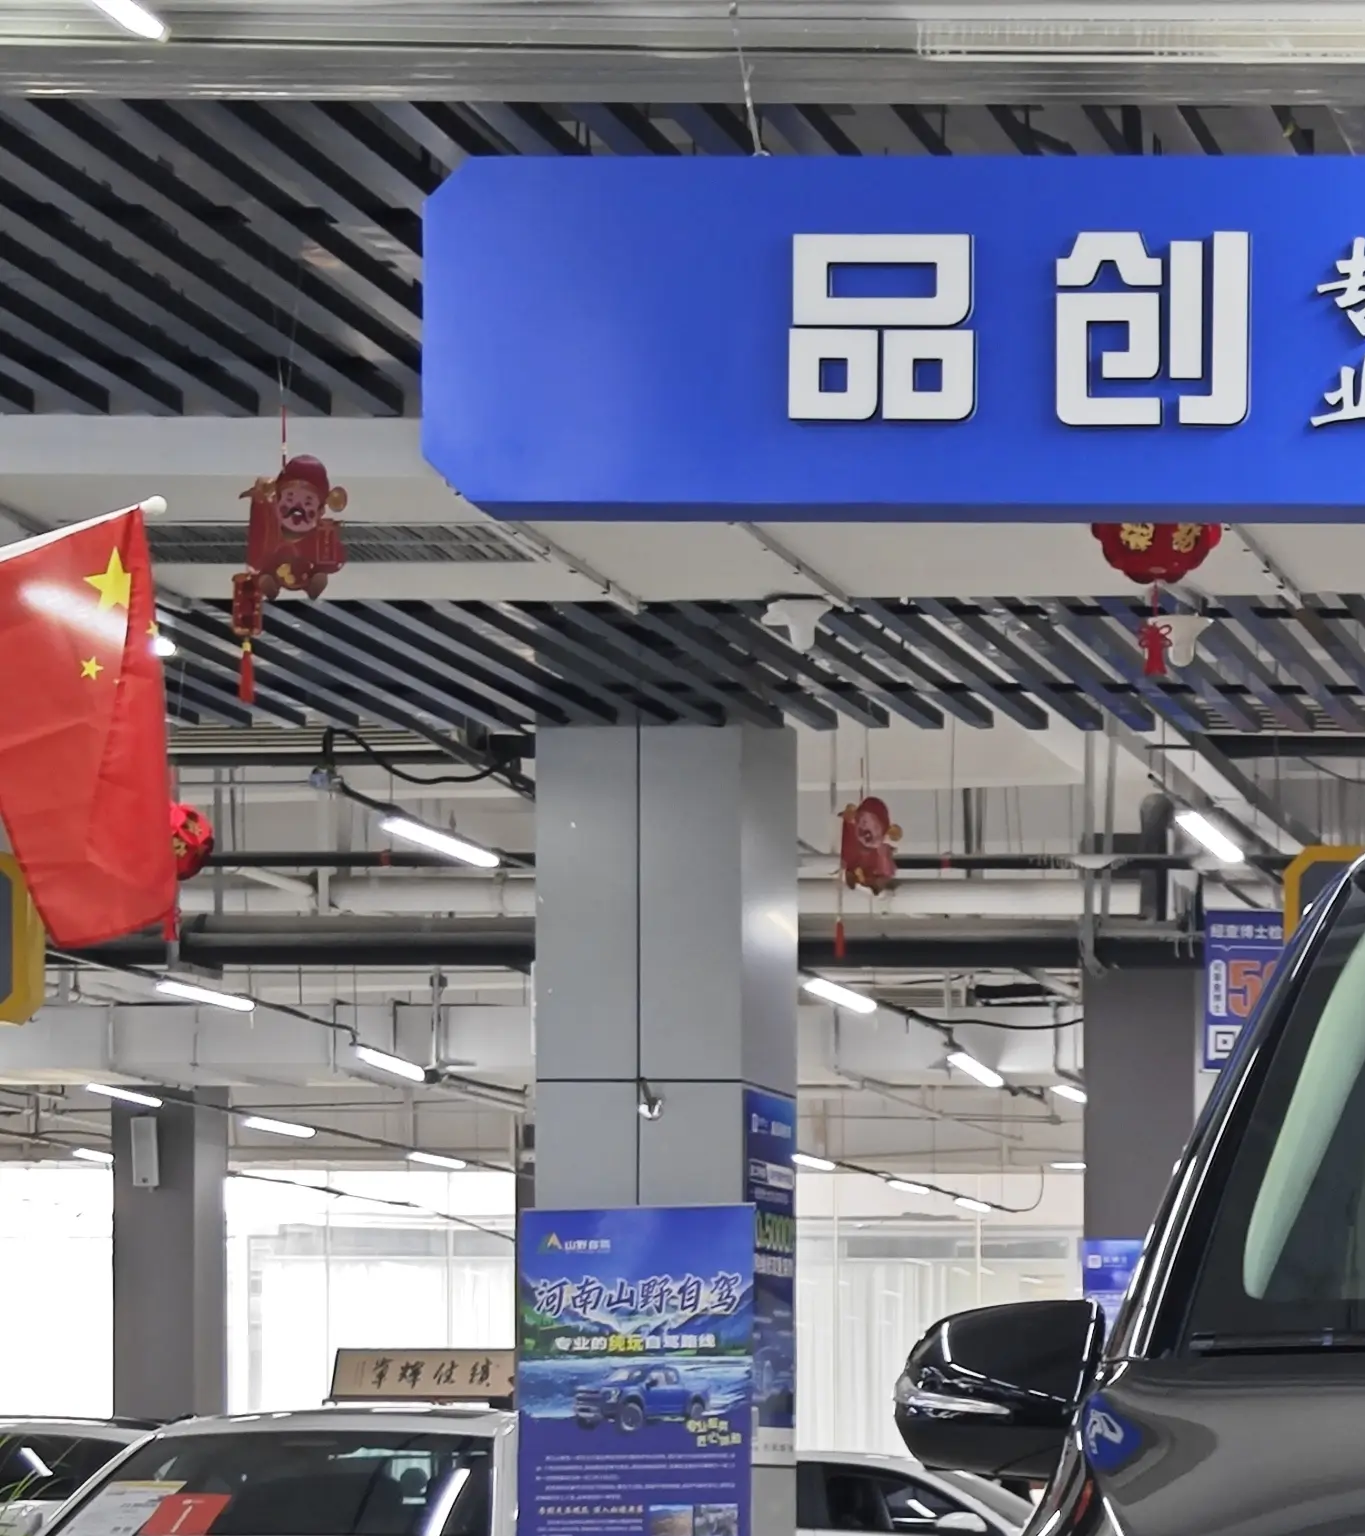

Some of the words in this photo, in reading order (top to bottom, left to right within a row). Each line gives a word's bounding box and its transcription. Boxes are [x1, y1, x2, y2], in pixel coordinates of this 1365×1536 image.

[788, 230, 1252, 427] 品创
[1228, 960, 1278, 1018] 5
[533, 1270, 743, 1318] 河南山野自驾
